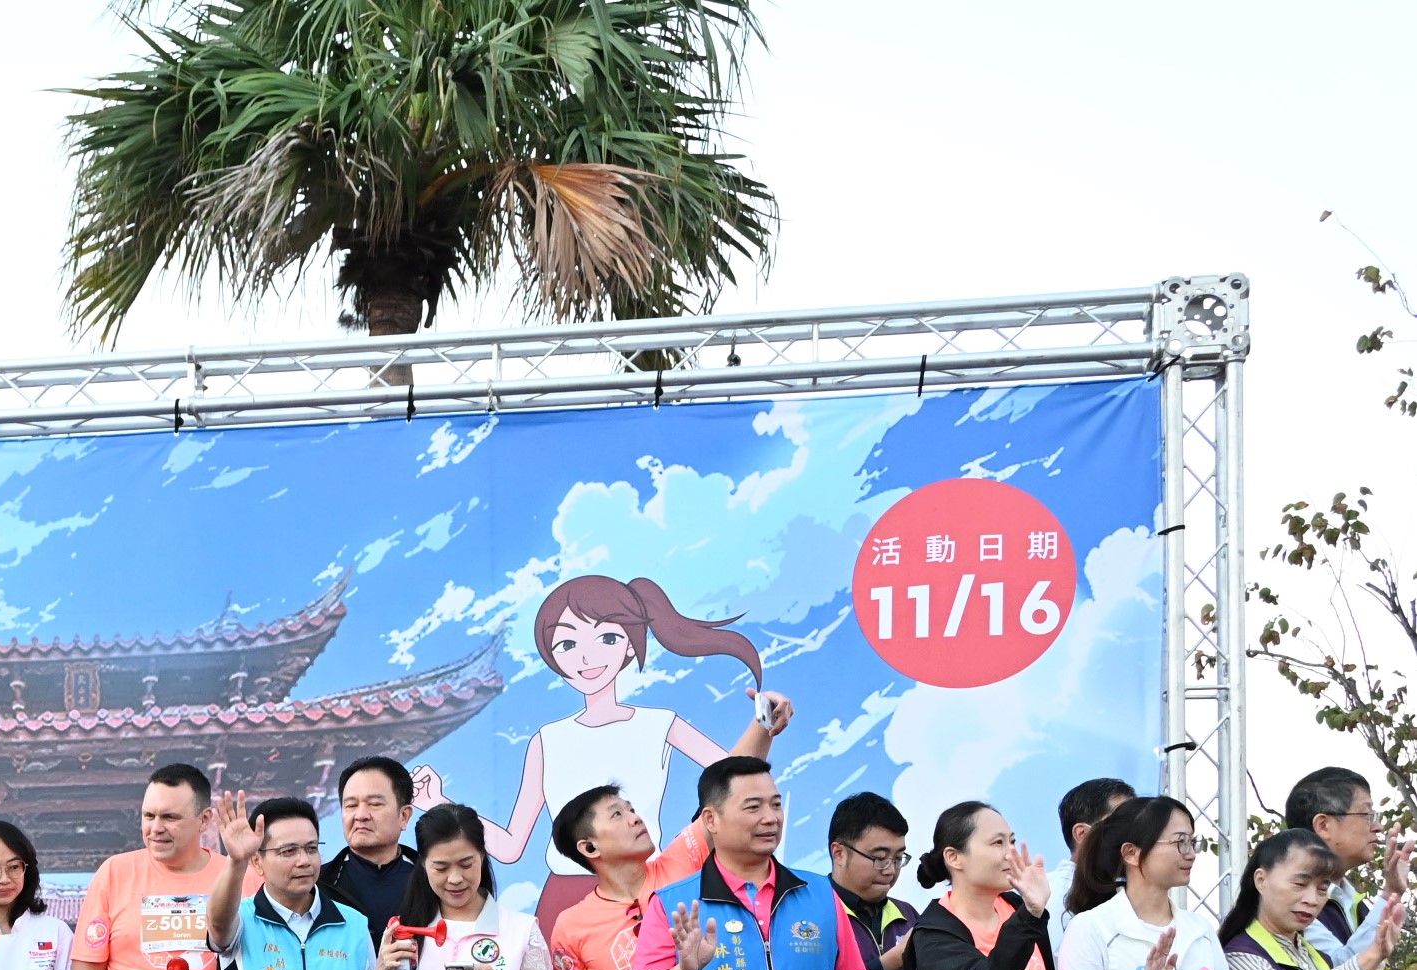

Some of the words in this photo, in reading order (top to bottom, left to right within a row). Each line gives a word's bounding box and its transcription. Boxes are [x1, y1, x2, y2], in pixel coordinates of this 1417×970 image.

[871, 531, 1059, 566] 活動日期
[870, 573, 1061, 640] 11/16
